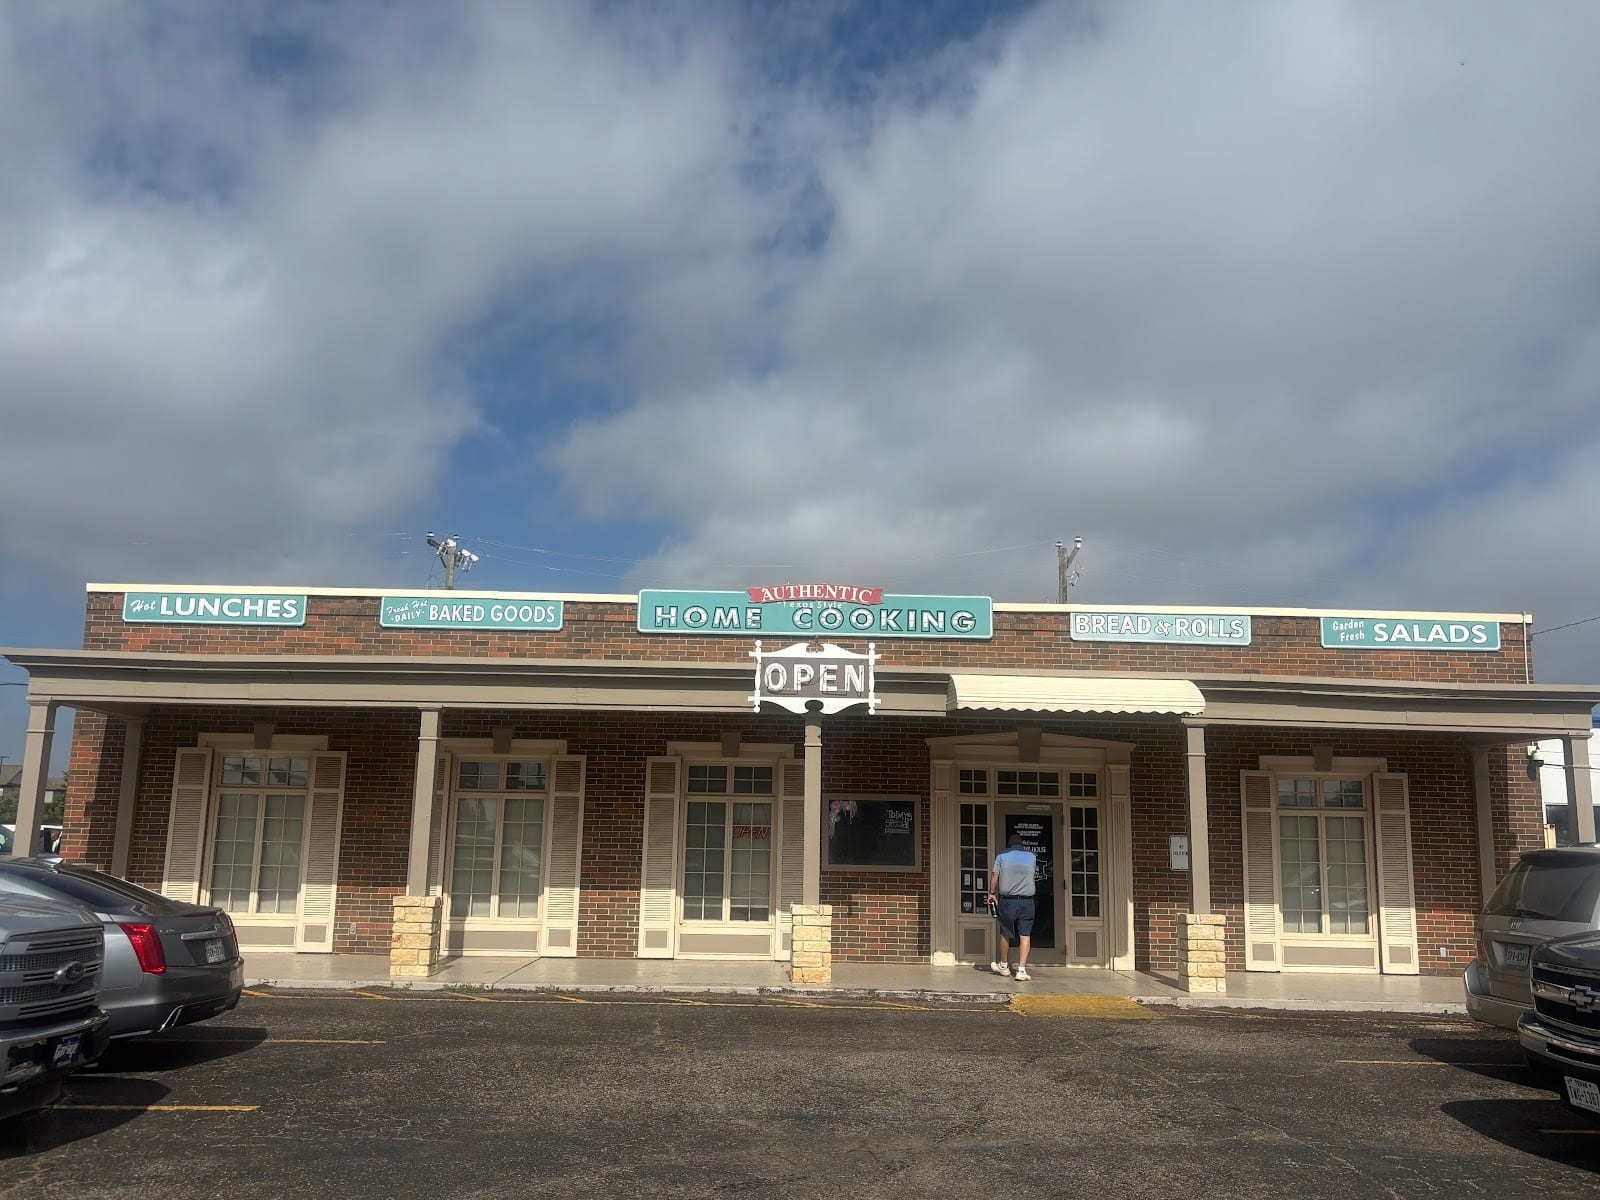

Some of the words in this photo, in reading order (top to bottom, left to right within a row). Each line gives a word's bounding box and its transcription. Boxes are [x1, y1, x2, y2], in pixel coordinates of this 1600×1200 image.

[761, 584, 872, 603] AUTHENTIC
[130, 599, 156, 613] Hot
[160, 596, 298, 618] LUNCHES
[386, 603, 409, 616] Fresh
[411, 599, 428, 609] Hot
[429, 604, 485, 622] BAKED
[490, 605, 555, 623] GOODS
[654, 605, 762, 630] HOME
[792, 606, 977, 633] COOKING
[1075, 614, 1151, 635] BREAD
[1154, 620, 1173, 637] &
[1175, 617, 1245, 639] ROLLS
[1332, 620, 1365, 631] Garden
[1340, 630, 1365, 642] Fresh
[1373, 623, 1488, 644] SALADS
[764, 662, 865, 693] OPEN
